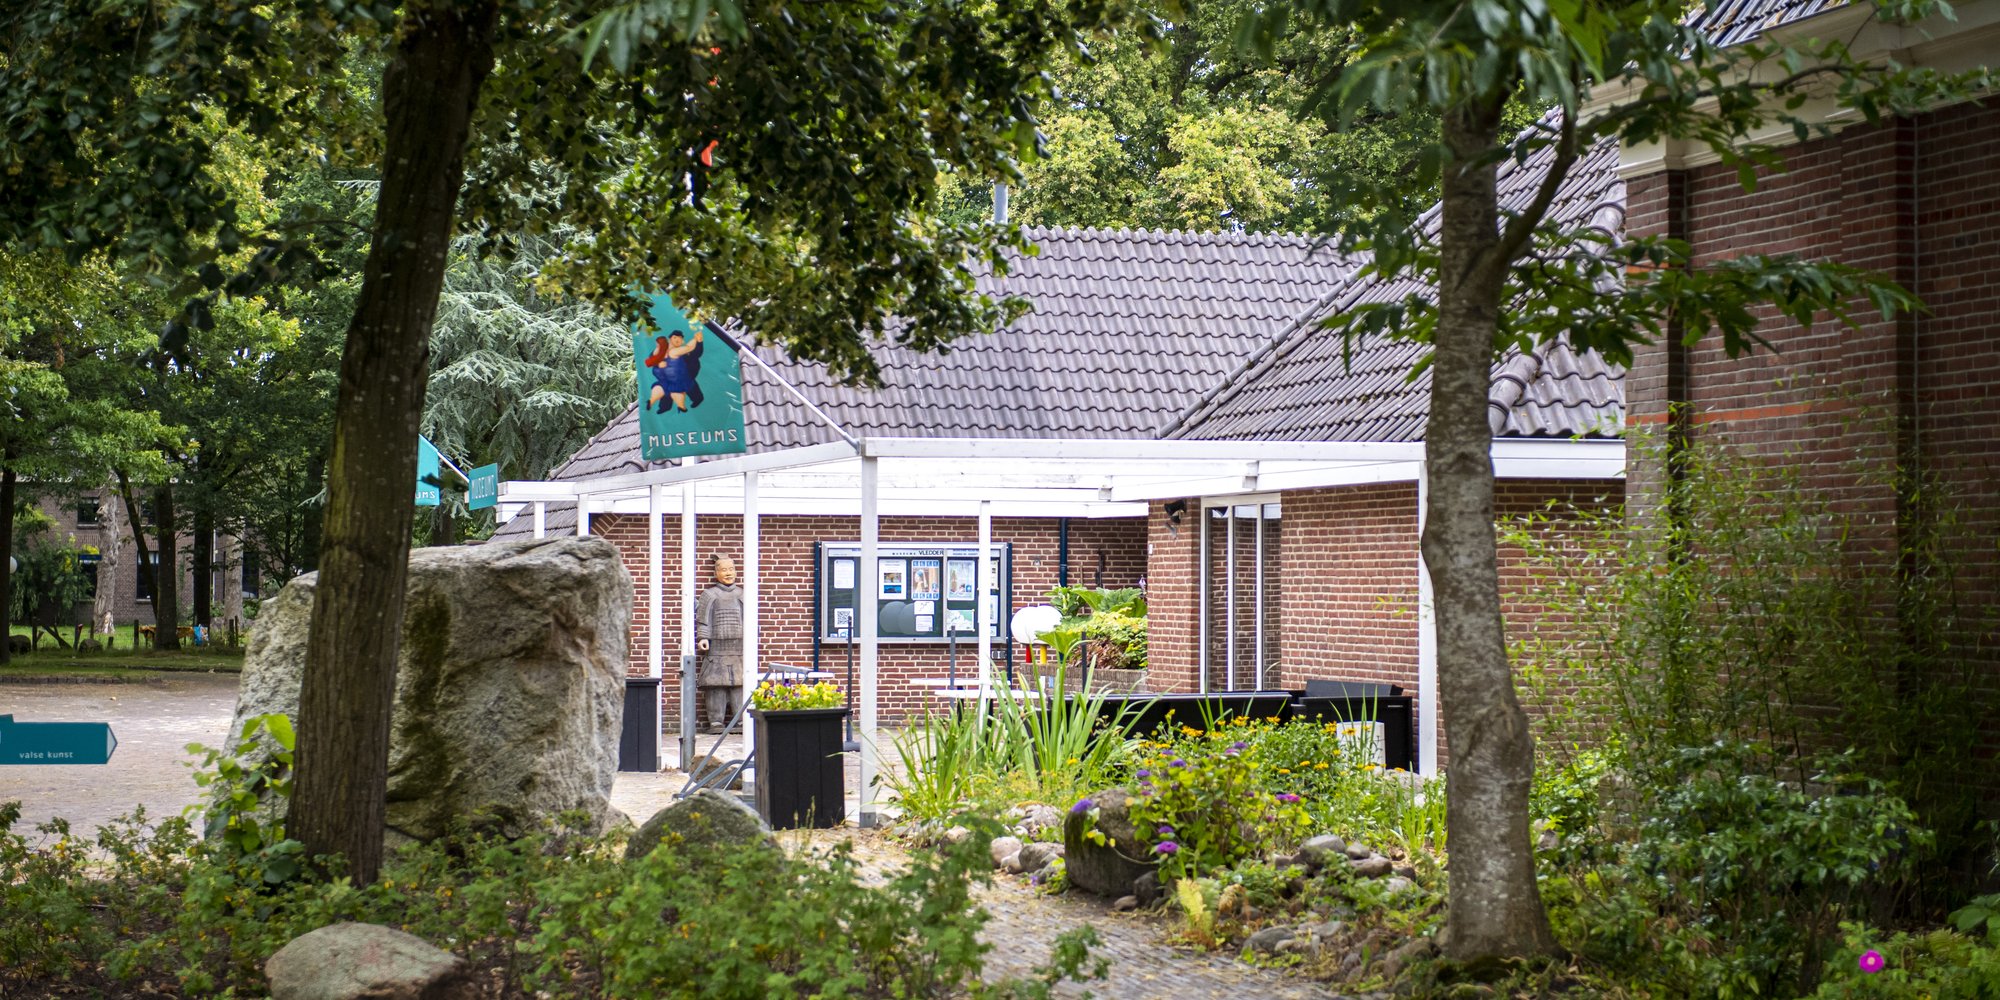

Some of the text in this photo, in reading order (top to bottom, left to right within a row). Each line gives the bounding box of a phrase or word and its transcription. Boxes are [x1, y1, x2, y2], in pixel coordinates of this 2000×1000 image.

[649, 429, 738, 447] MUSEUMS
[19, 751, 74, 759] valse kunst
